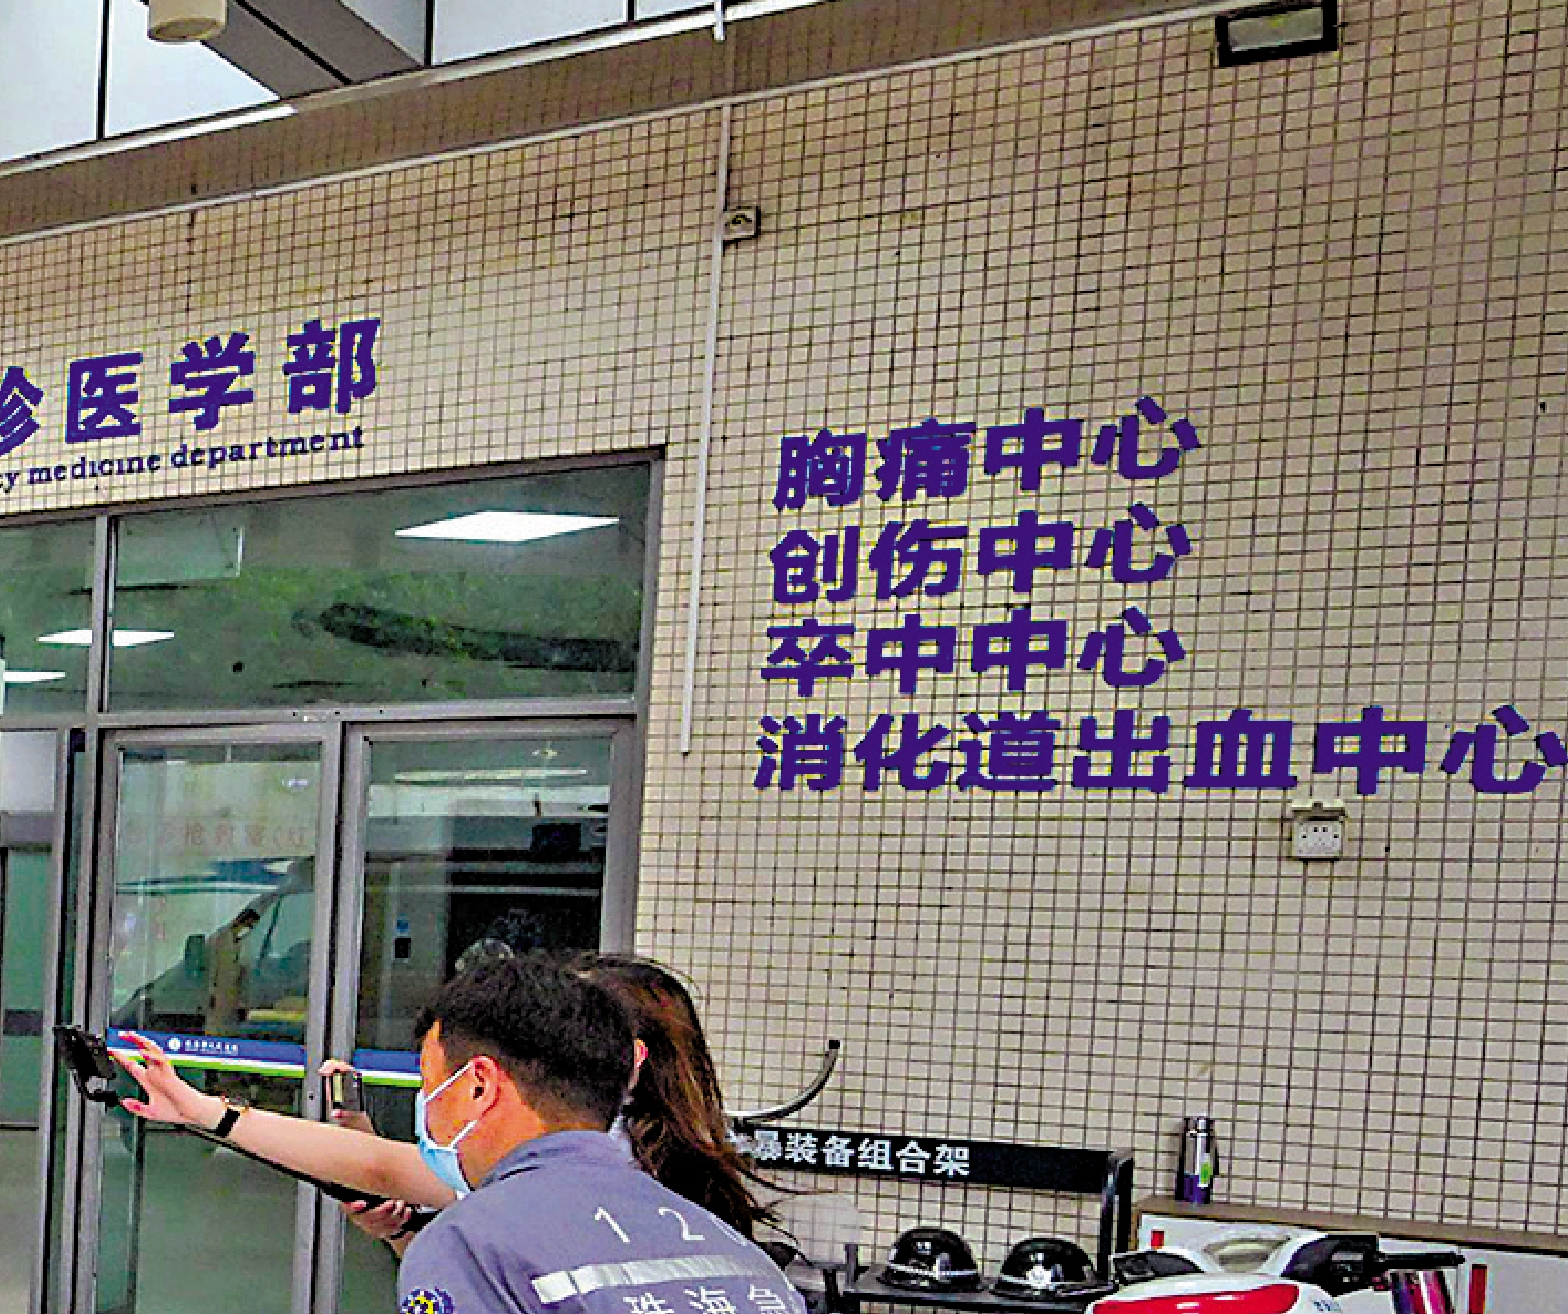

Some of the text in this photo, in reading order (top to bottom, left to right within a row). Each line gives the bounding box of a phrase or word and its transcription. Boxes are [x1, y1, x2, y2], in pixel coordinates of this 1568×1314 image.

[28, 453, 161, 485] medicine
[169, 425, 364, 471] department
[773, 396, 1200, 511] 胸痛中心
[769, 502, 1192, 603] 创伤中心
[761, 606, 1186, 697] 卒中中心
[753, 703, 1567, 795] 消化道出血中心
